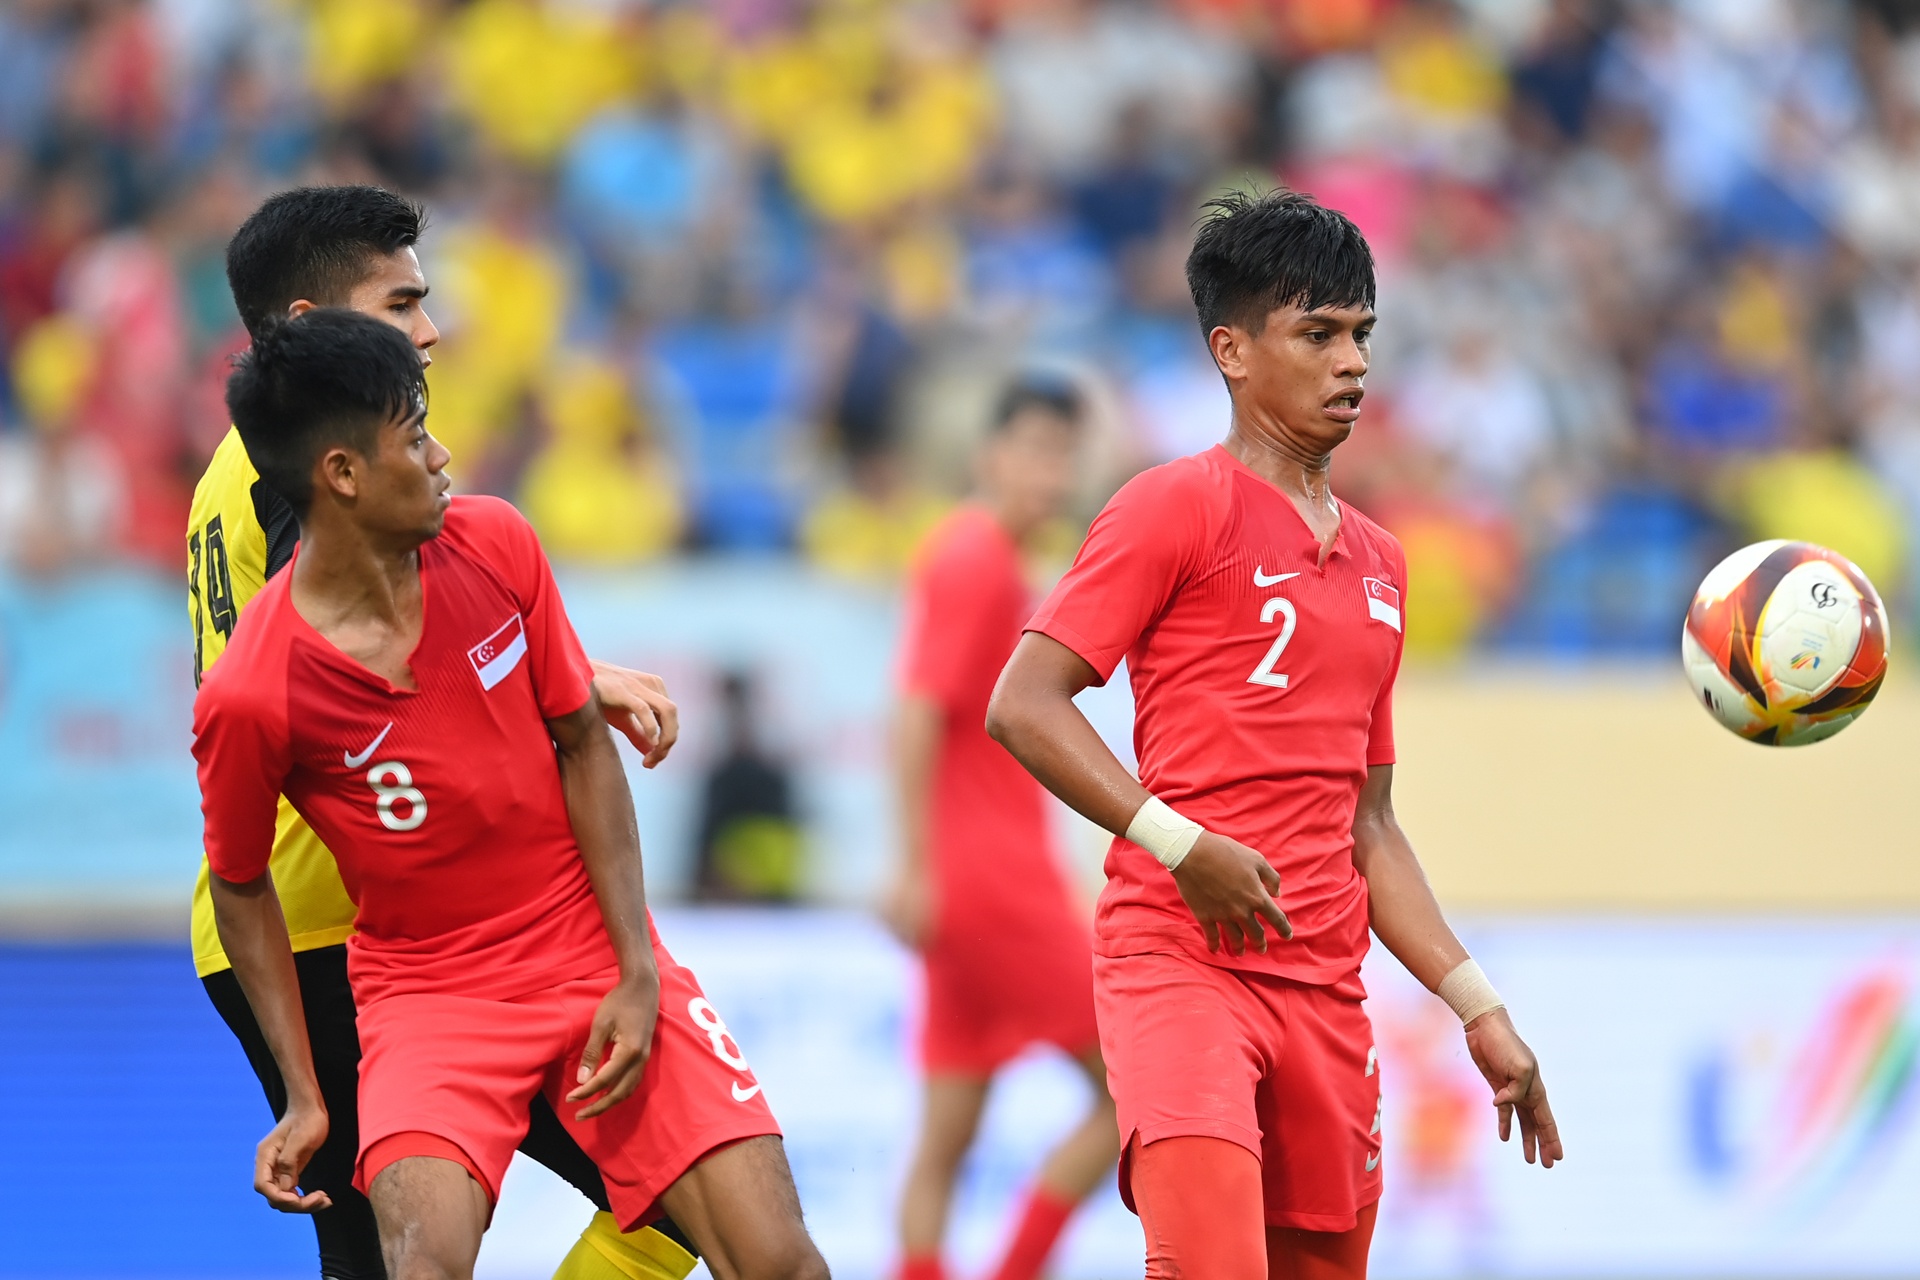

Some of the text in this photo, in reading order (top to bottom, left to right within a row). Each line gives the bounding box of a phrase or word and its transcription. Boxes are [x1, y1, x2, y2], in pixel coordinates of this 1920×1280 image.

[1246, 597, 1297, 688] 2
[366, 761, 428, 831] 8
[687, 996, 749, 1071] 8
